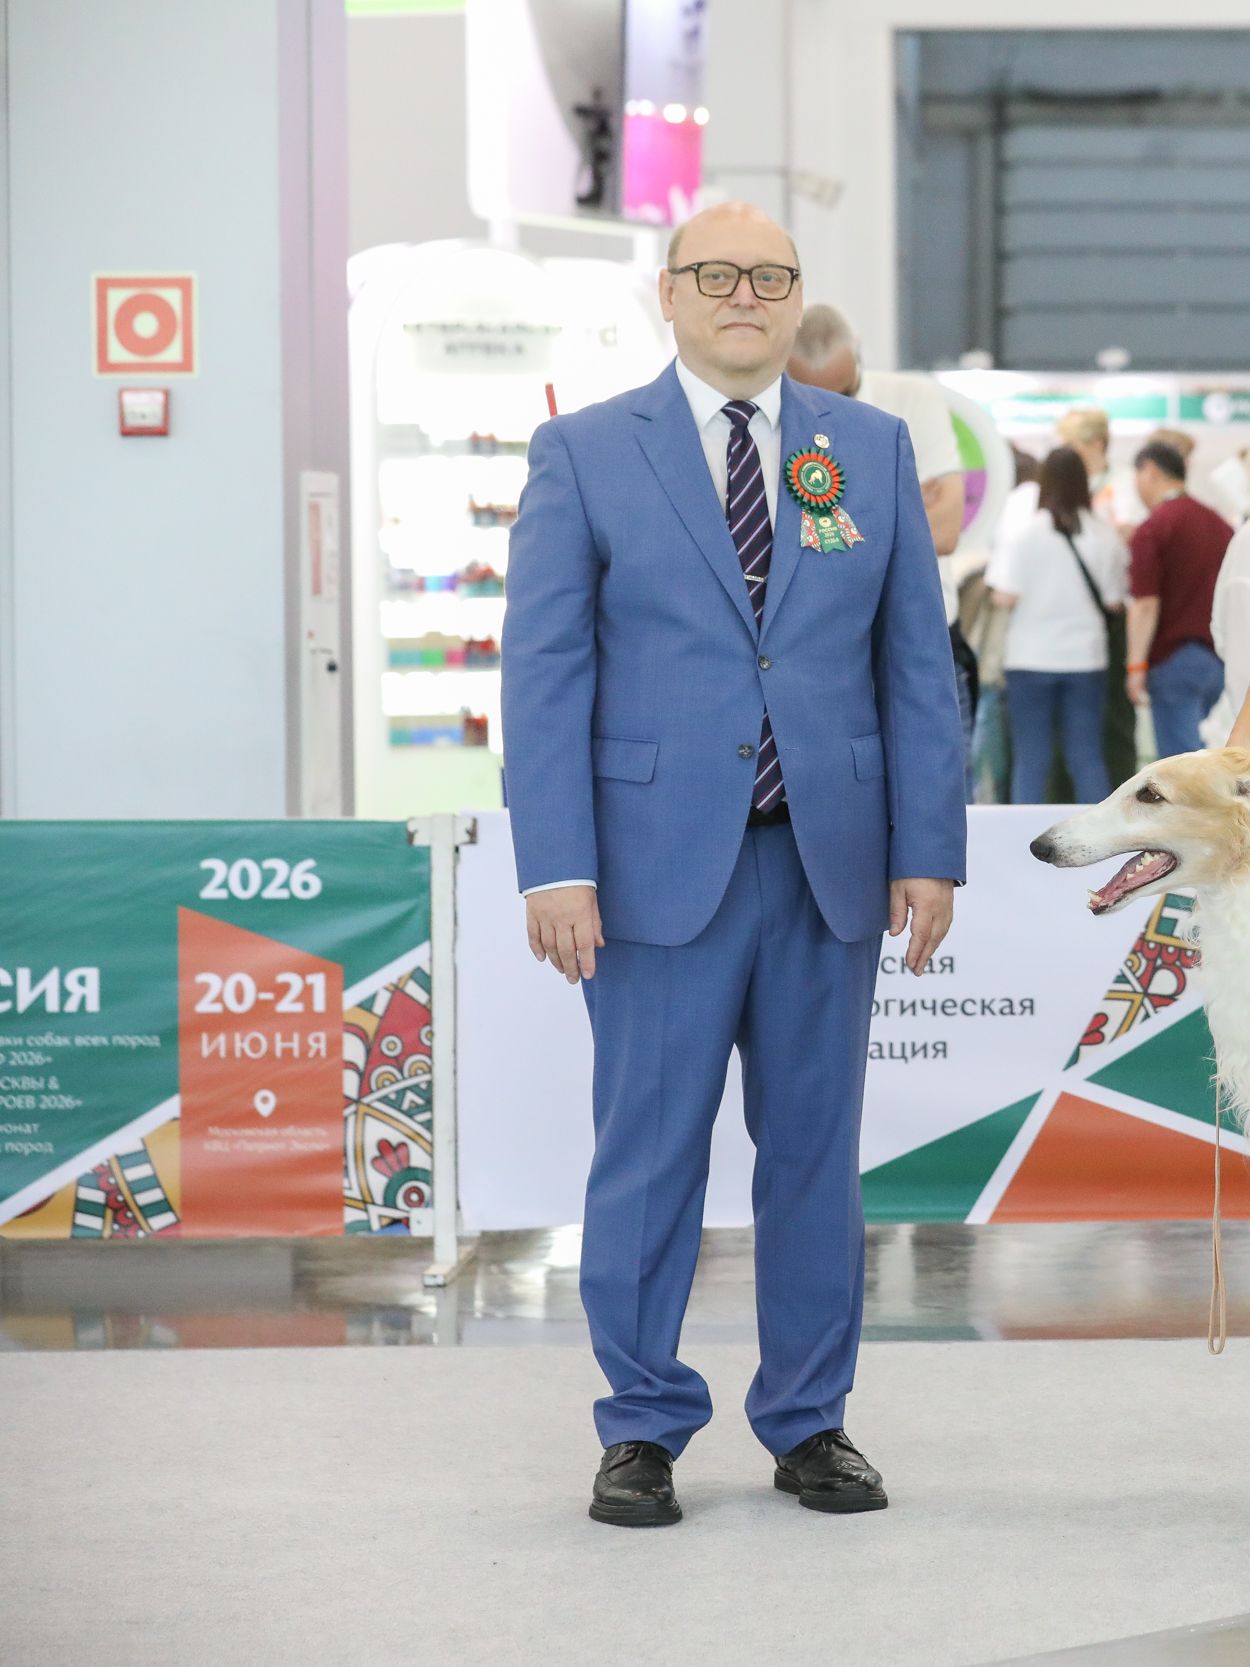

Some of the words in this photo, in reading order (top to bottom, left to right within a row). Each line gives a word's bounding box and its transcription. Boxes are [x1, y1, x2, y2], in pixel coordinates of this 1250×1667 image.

[199, 857, 323, 900] 2026
[194, 971, 327, 1014] 20-21
[26, 1032, 71, 1047] собак
[111, 1035, 161, 1049] пород
[201, 1031, 328, 1060] ИЮНЯ
[869, 1040, 948, 1064] ация
